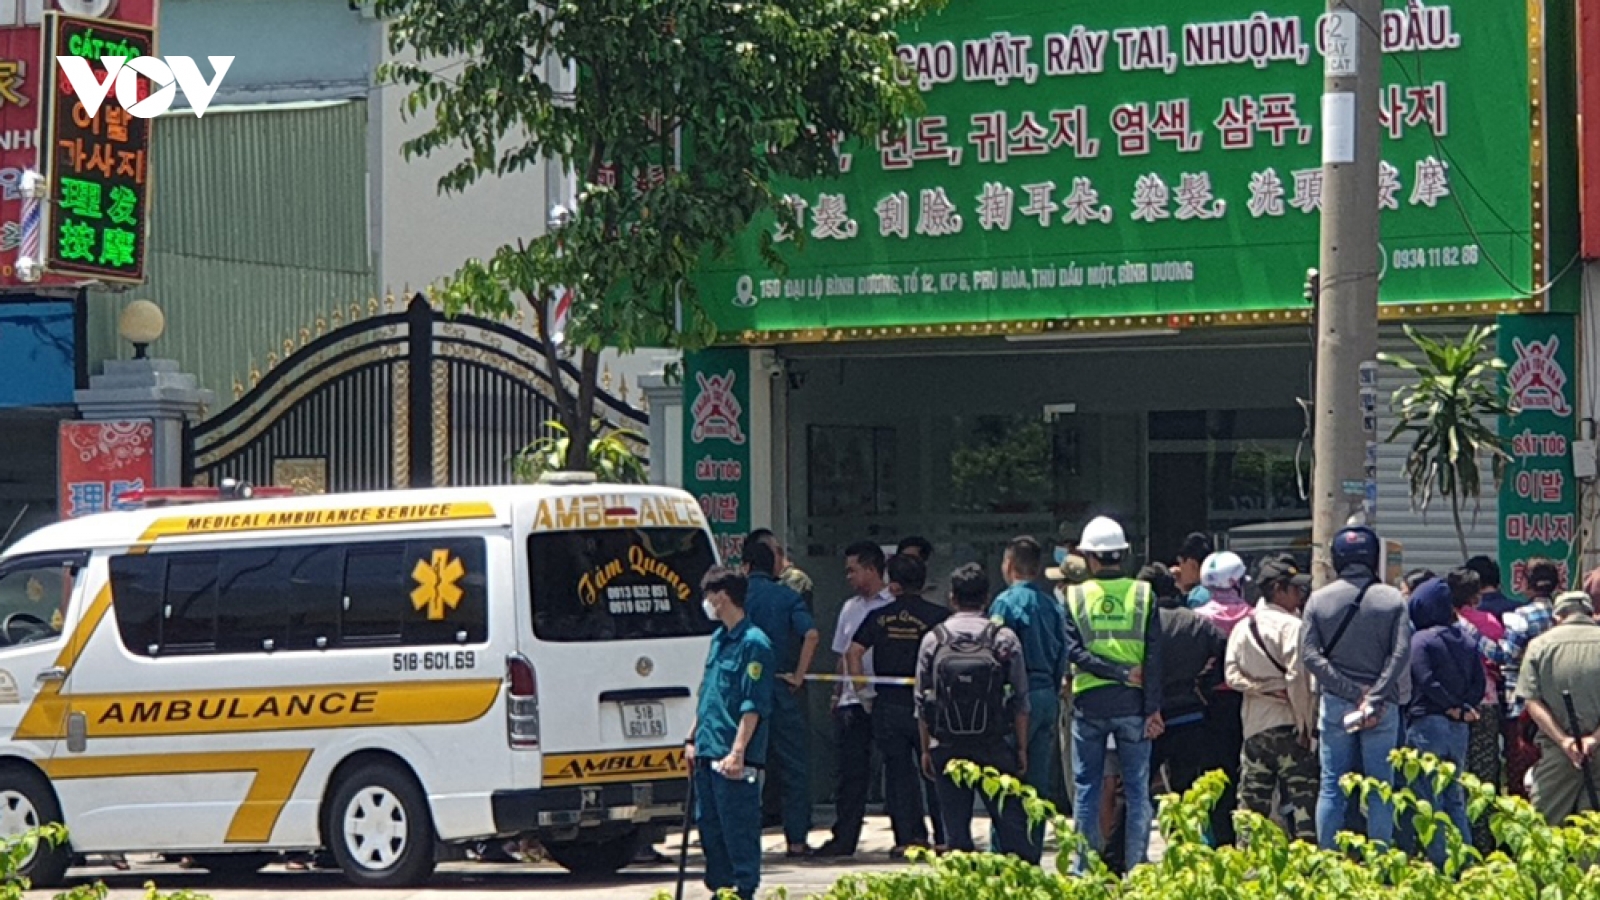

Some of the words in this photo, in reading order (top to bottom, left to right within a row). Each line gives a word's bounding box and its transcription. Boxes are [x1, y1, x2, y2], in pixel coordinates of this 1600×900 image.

[963, 31, 1038, 86] MẶT,
[1044, 25, 1108, 75] RÁY
[1114, 25, 1177, 74] TAI,
[1182, 12, 1309, 70] NHUỘM,
[968, 105, 1099, 163] 귀소지,
[1110, 97, 1204, 156] 염색,
[1213, 92, 1312, 149] 샴푸,
[60, 218, 137, 267] 按摩
[1393, 248, 1426, 269] 0934
[1427, 248, 1441, 267] 11
[1516, 468, 1563, 503] 이발
[187, 514, 260, 530] MEDICAL
[266, 507, 371, 526] AMBULANCE
[375, 502, 452, 520] SERIVCE
[533, 493, 701, 530] AMBULANCE
[1506, 512, 1574, 546] 마사지
[628, 545, 692, 601] Quang
[98, 690, 379, 724] AMBULANCE
